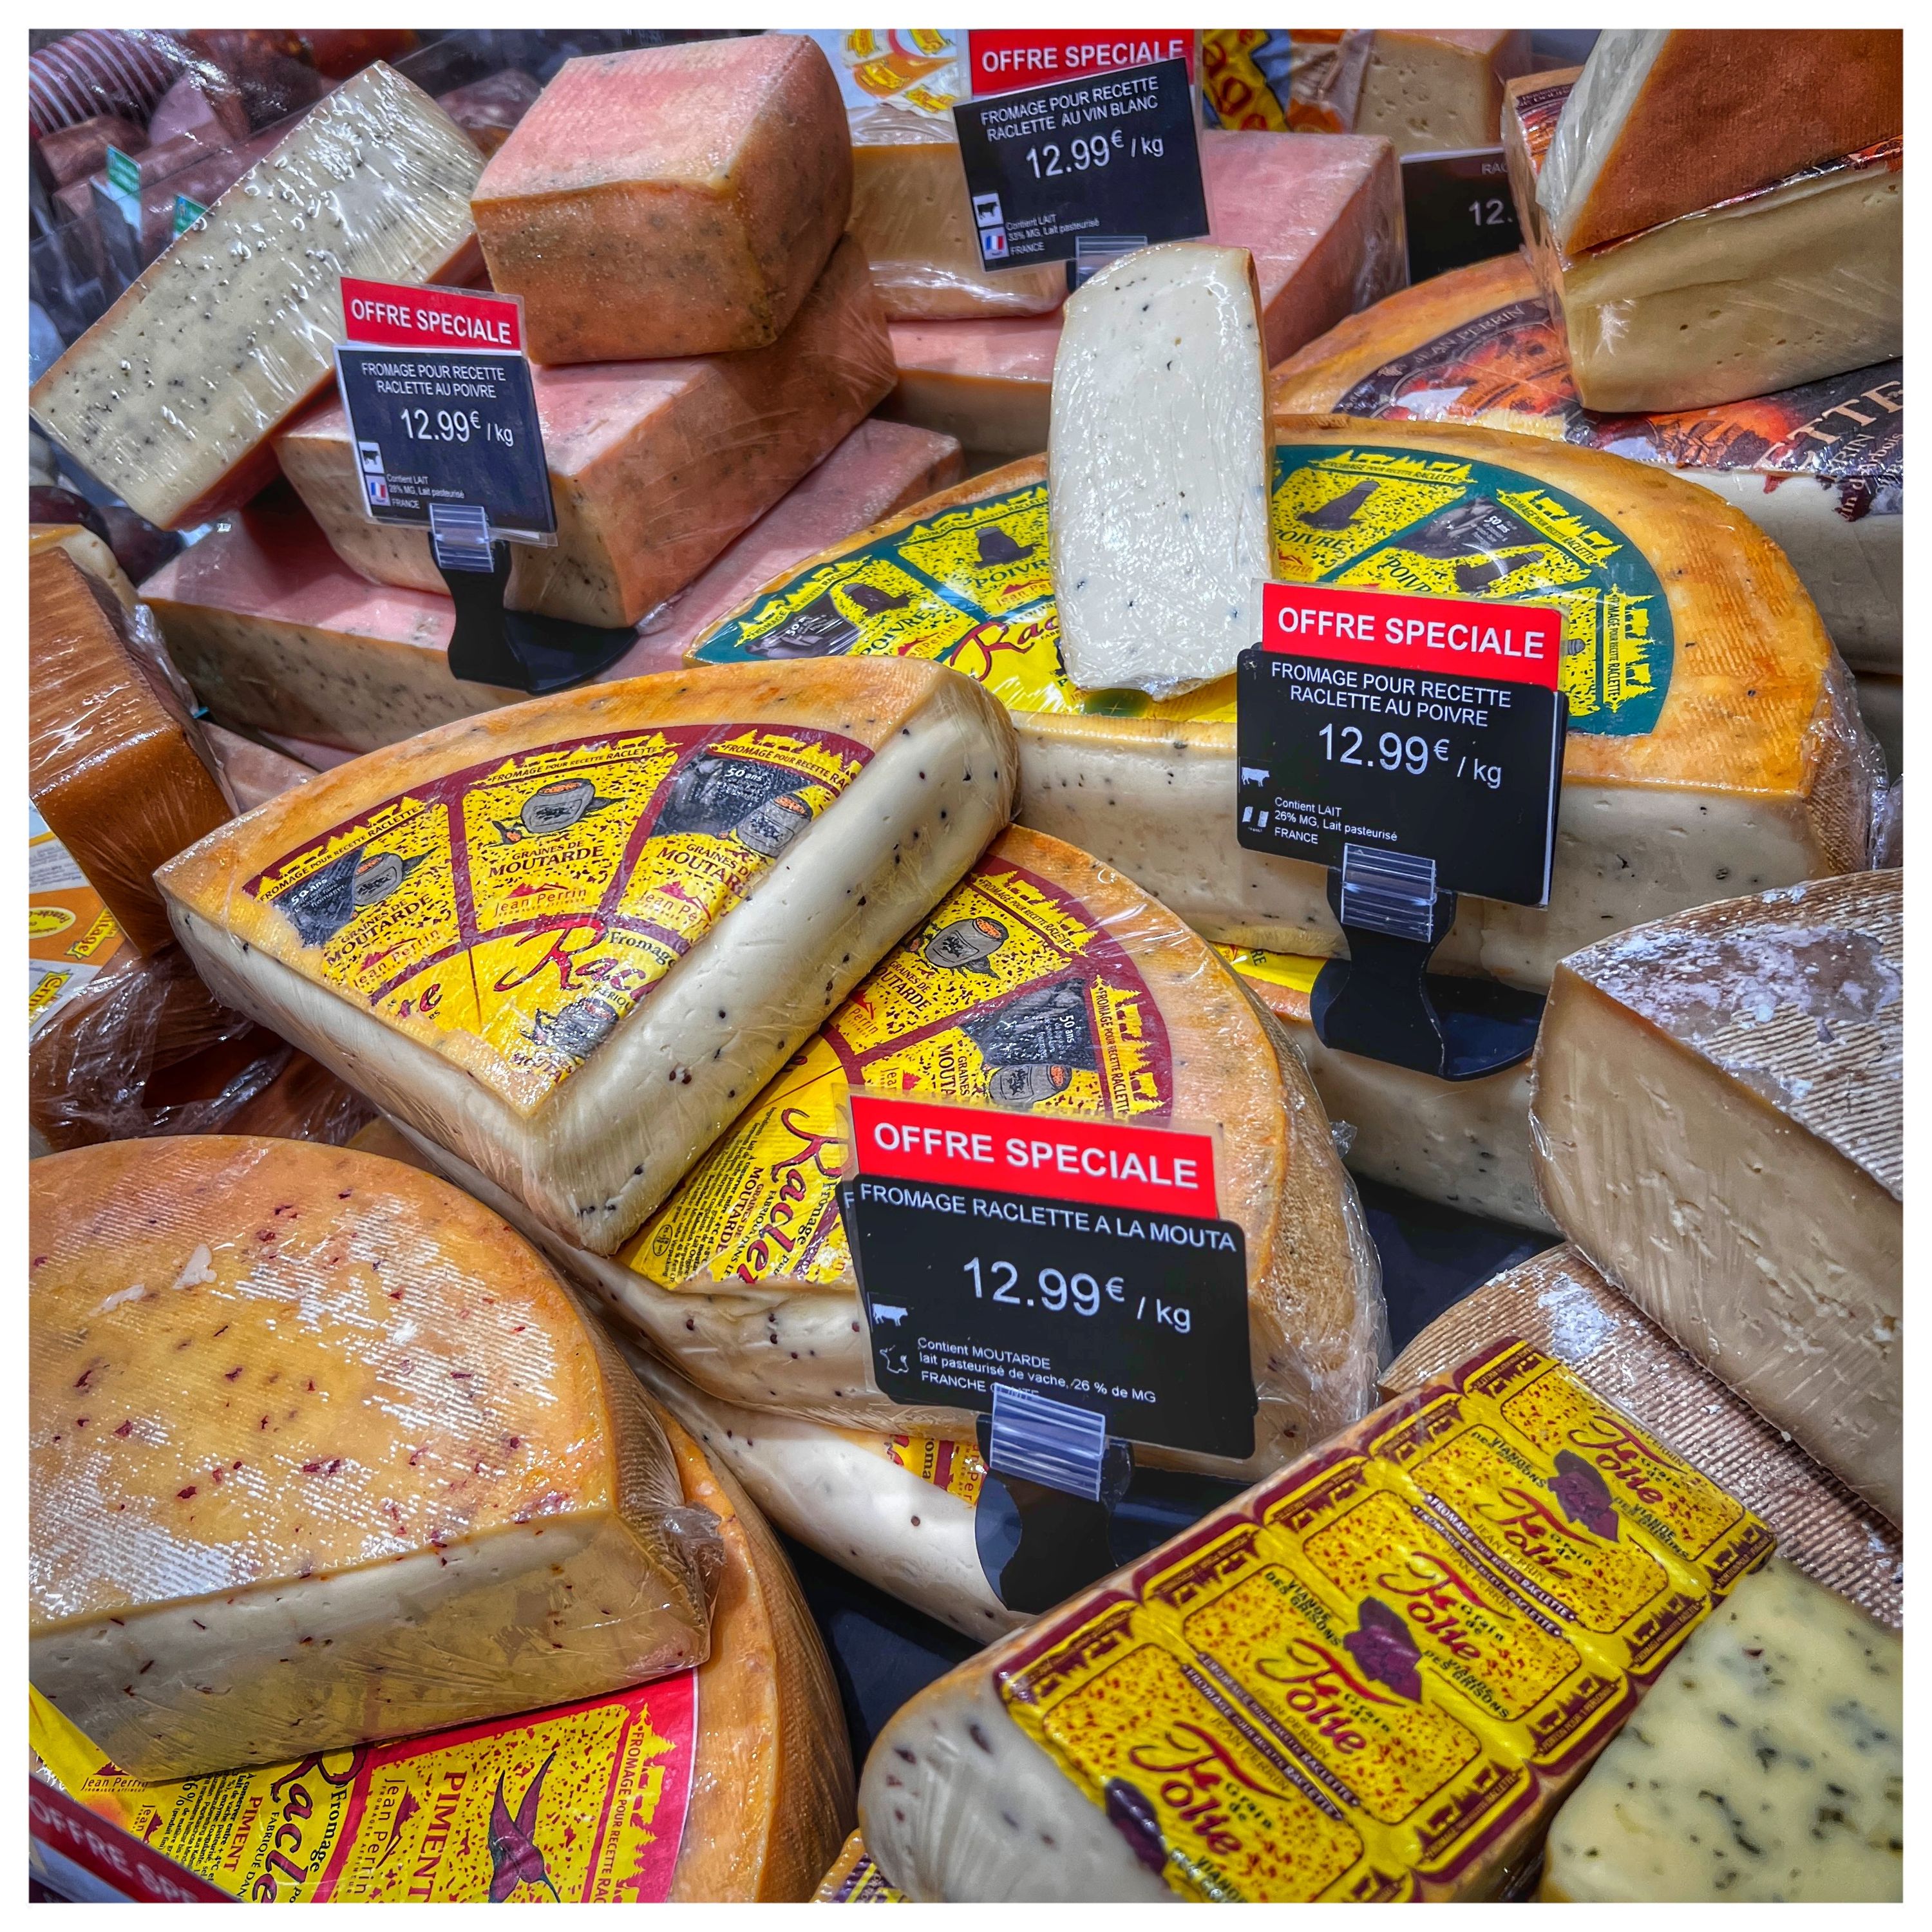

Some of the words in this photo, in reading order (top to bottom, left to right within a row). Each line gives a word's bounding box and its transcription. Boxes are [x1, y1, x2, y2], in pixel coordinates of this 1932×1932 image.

[981, 47, 1058, 73] OFFRE
[1065, 39, 1184, 68] SPECIALE
[981, 100, 1046, 126] FROMAGE
[1050, 91, 1090, 113] POUR
[1094, 77, 1159, 104] RECETTE
[987, 118, 1056, 142] RACLETTE
[1061, 112, 1080, 126] AU
[1085, 108, 1108, 122] VIN
[1111, 96, 1158, 117] BLANC
[1026, 130, 1124, 179] 12.99€
[1142, 137, 1164, 156] kg
[1037, 214, 1056, 225] LAIT
[1059, 218, 1099, 234] pasteurisé
[1468, 198, 1513, 226] 12.
[1010, 242, 1045, 255] FRANCE
[351, 299, 412, 328] OFFRE
[417, 309, 512, 345] SPECIALE
[361, 363, 416, 377] FROMAGE
[419, 365, 450, 379] POUR
[453, 366, 506, 381] RECETTE
[376, 381, 433, 396] RACLETTE
[435, 383, 451, 396] AU
[453, 384, 497, 399] POIVRE
[401, 408, 481, 442] 12.99€
[495, 424, 513, 446] kg
[413, 476, 429, 484] LAIT
[392, 498, 420, 509] FRANCE
[913, 523, 955, 540] FROMAGE
[1563, 536, 1595, 560] RACLETTE
[750, 610, 787, 637] FROMAGE
[823, 565, 859, 586] RACLETTE
[1278, 607, 1374, 641] OFFRE
[1385, 618, 1545, 659] SPECIALE
[1609, 640, 1618, 661] RECETTE
[1271, 662, 1357, 688] FROMAGE
[1363, 674, 1415, 695] POUR
[1421, 681, 1511, 708] RECETTE
[1607, 663, 1620, 697] RACLETTE
[1291, 685, 1381, 712] RACLETTE
[1385, 699, 1411, 717] AU
[1417, 704, 1488, 727] POIVRE
[492, 765, 543, 782] FROMAGE
[545, 761, 567, 771] POUR
[570, 755, 603, 766] RECETTE
[606, 746, 658, 760] RACLETTE
[724, 743, 773, 759] FROMAGE
[773, 753, 797, 764] POUR
[797, 758, 829, 778] RECETTE
[724, 768, 745, 778] 50
[1319, 723, 1450, 775] 12.99€
[1457, 756, 1466, 777] /
[1473, 759, 1502, 789] kg
[1274, 796, 1316, 813] Contient
[1318, 804, 1341, 817] LAIT
[1274, 810, 1296, 823] 26%
[1300, 814, 1320, 828] MG,
[1323, 817, 1342, 831] Lait
[1344, 822, 1397, 842] pasteurisé
[1274, 827, 1318, 845] FRANCE
[260, 866, 309, 902] FROMAGE
[310, 854, 333, 869] POUR
[334, 835, 367, 858] RECETTE
[367, 806, 419, 837] RACLETTE
[489, 846, 605, 878] MOUTARDE
[512, 844, 565, 860] GRAINES
[568, 840, 584, 849] DE
[687, 843, 737, 869] GRAINES
[494, 898, 529, 917] Jean
[537, 889, 587, 905] Perrin
[639, 891, 674, 913] Jean
[983, 880, 1014, 903] FROMAGE
[1024, 907, 1048, 926] RECETTE
[327, 894, 433, 965] MOUTARDE
[341, 911, 388, 943] GRAINES
[391, 898, 408, 911] DE
[392, 930, 439, 961] Perrin
[889, 960, 920, 984] GRAINES
[916, 981, 931, 993] DE
[849, 1008, 878, 1034] Perrin
[1096, 990, 1113, 1027] FROMAGE
[1104, 1027, 1114, 1045] POUR
[1107, 1043, 1121, 1073] RECETTE
[958, 1056, 970, 1095] GRAINES
[874, 1121, 994, 1163] OFFRE
[1006, 1137, 1198, 1189] SPECIALE
[715, 1166, 763, 1256] MOUTARDE
[721, 1195, 733, 1214] entre
[741, 1183, 764, 1223] GRAINES
[860, 1183, 966, 1215] FROMAGE
[973, 1198, 1090, 1232] RACLETTE
[1095, 1217, 1112, 1235] A
[1117, 1218, 1145, 1239] LA
[1150, 1222, 1236, 1253] MOUTA
[963, 1257, 1124, 1316] 12.99€
[1137, 1296, 1145, 1320] /
[1157, 1298, 1191, 1333] kg
[917, 1337, 969, 1356] Contient
[972, 1346, 1051, 1370] MOUTARDE
[920, 1352, 938, 1366] lait
[942, 1357, 1005, 1377] pasteurisé
[1009, 1367, 1025, 1381] de
[1028, 1371, 1070, 1388] vache,
[1094, 1382, 1108, 1395] %
[1112, 1386, 1128, 1398] de
[1132, 1388, 1157, 1403] MG
[921, 1371, 987, 1393] FRANCHE
[1430, 1497, 1474, 1540] FROMAGE
[1472, 1539, 1493, 1558] POUR
[1491, 1556, 1522, 1582] RECETTE
[1521, 1579, 1567, 1617] RACLETTE
[1376, 1551, 1515, 1662] Folie
[1460, 1604, 1505, 1642] Grain
[1256, 1637, 1406, 1754] Folie
[1343, 1693, 1391, 1732] Grain
[621, 1731, 645, 1797] FROMAGE
[82, 1777, 109, 1791] Jean
[230, 1789, 238, 1799] de
[230, 1781, 250, 1821] conserver
[379, 1779, 406, 1821] Jean
[1128, 1720, 1291, 1855] Folie
[136, 1802, 155, 1833] Jean
[164, 1807, 180, 1835] (produit
[181, 1807, 189, 1816] de
[213, 1794, 227, 1822] enzyme
[221, 1800, 234, 1822] vache
[615, 1797, 629, 1825] POUR
[1225, 1782, 1273, 1829] Grain
[170, 1817, 185, 1843] matière
[204, 1824, 224, 1864] pasteurisé,
[220, 1823, 232, 1845] entre
[223, 1794, 263, 1871] PIMENT
[310, 1786, 347, 1872] Fromage
[408, 1772, 468, 1902] PIMENT
[354, 1831, 388, 1894] Perrin
[603, 1827, 624, 1875] RECETTE
